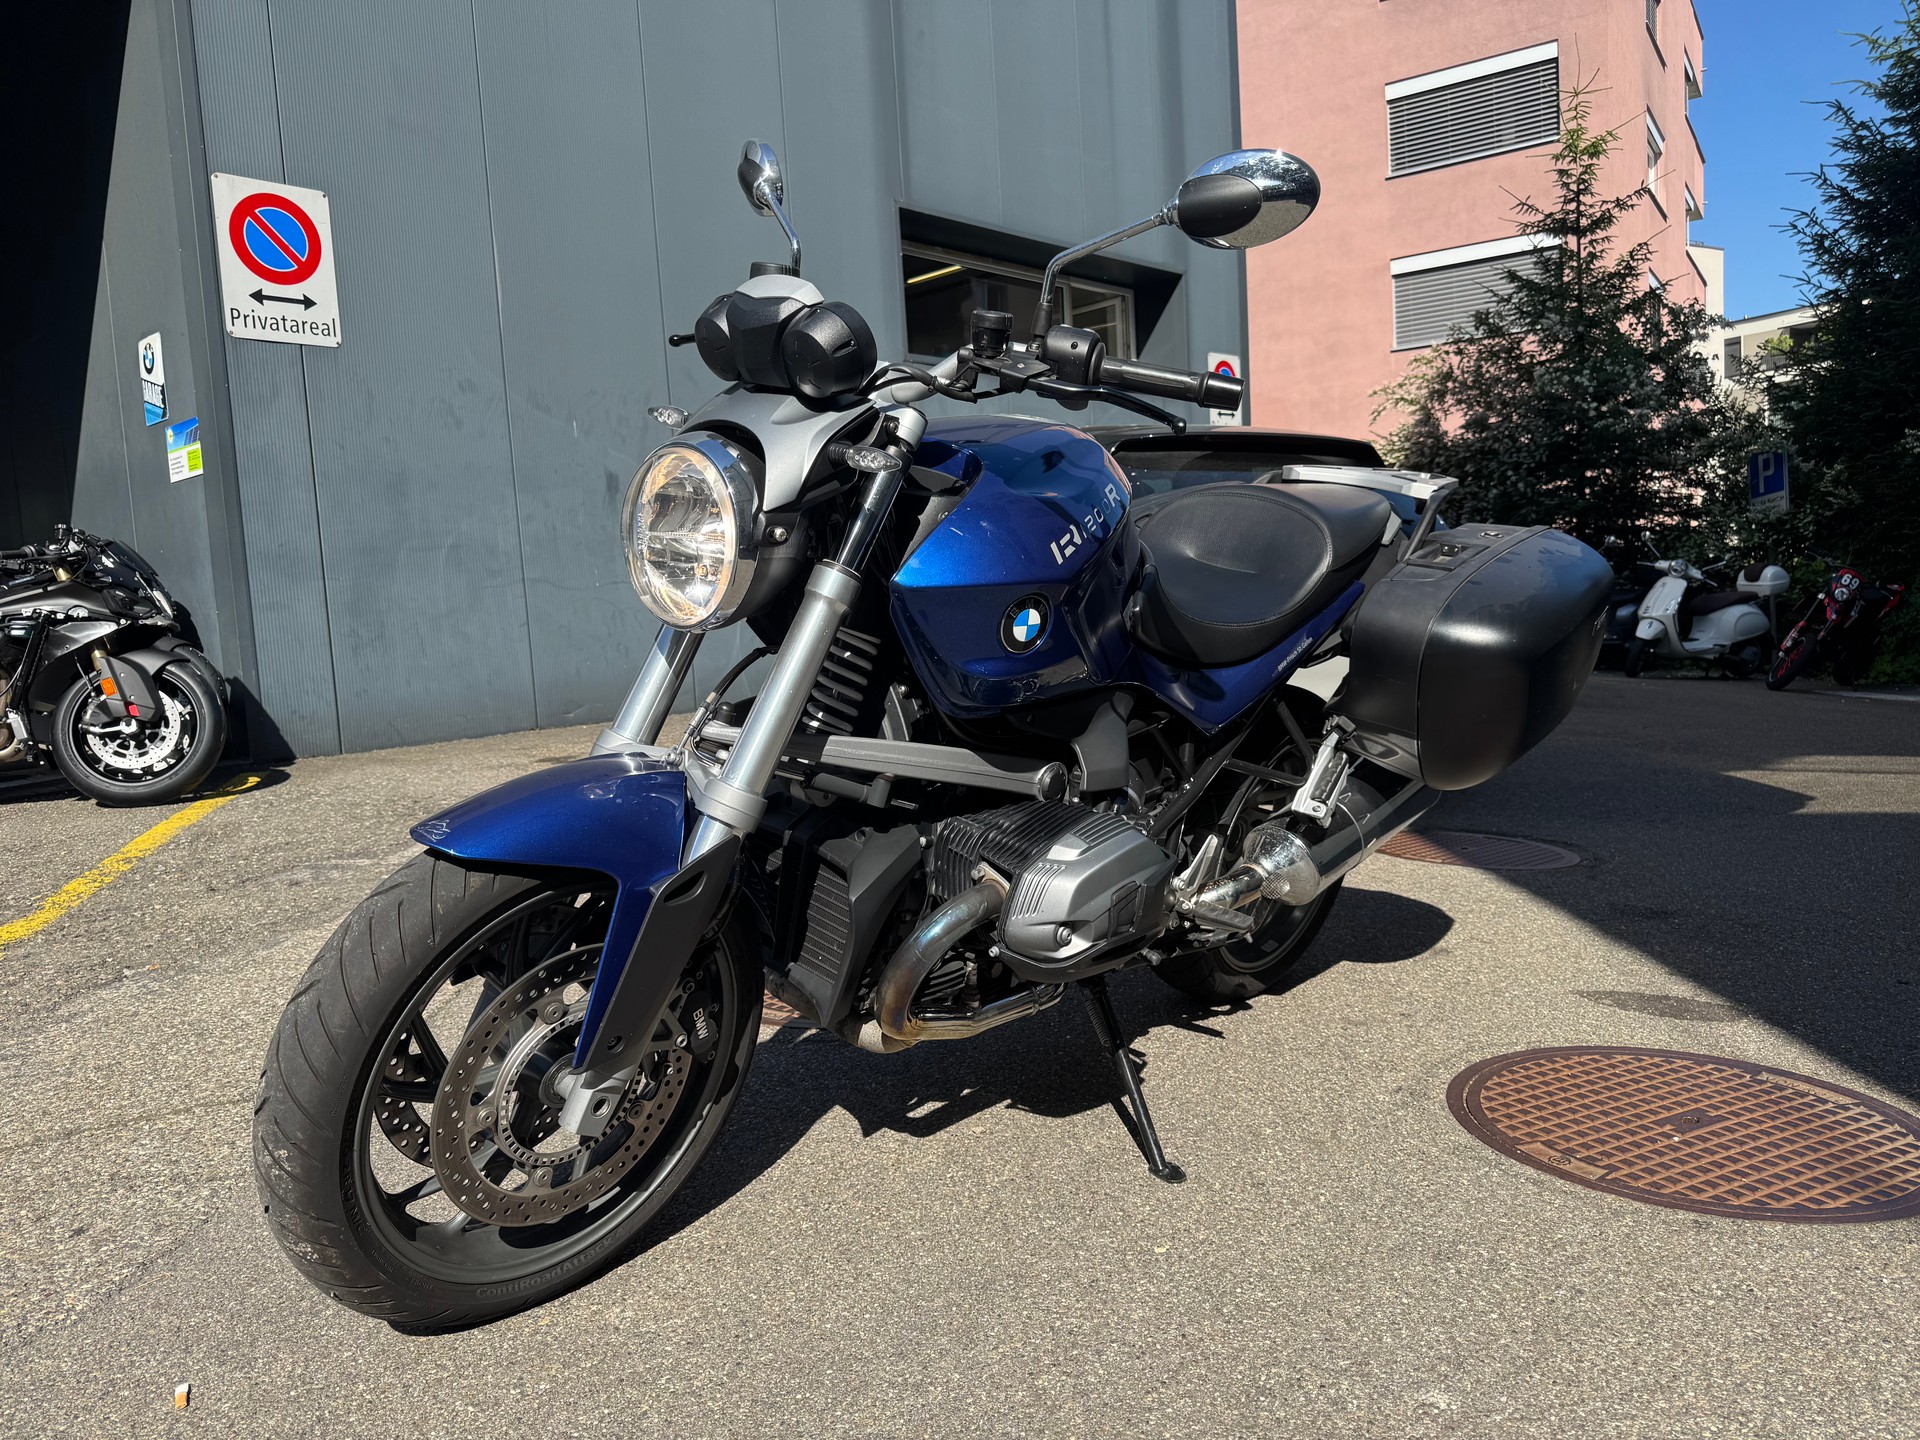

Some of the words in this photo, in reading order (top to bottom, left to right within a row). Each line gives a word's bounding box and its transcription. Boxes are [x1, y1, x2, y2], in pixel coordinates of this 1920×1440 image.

[230, 307, 337, 338] Privatareal
[1758, 452, 1775, 494] P
[1840, 573, 1860, 590] 69
[1010, 599, 1047, 619] BMW
[693, 1007, 709, 1040] BMW
[475, 1234, 617, 1299] ContiRoadAttack
